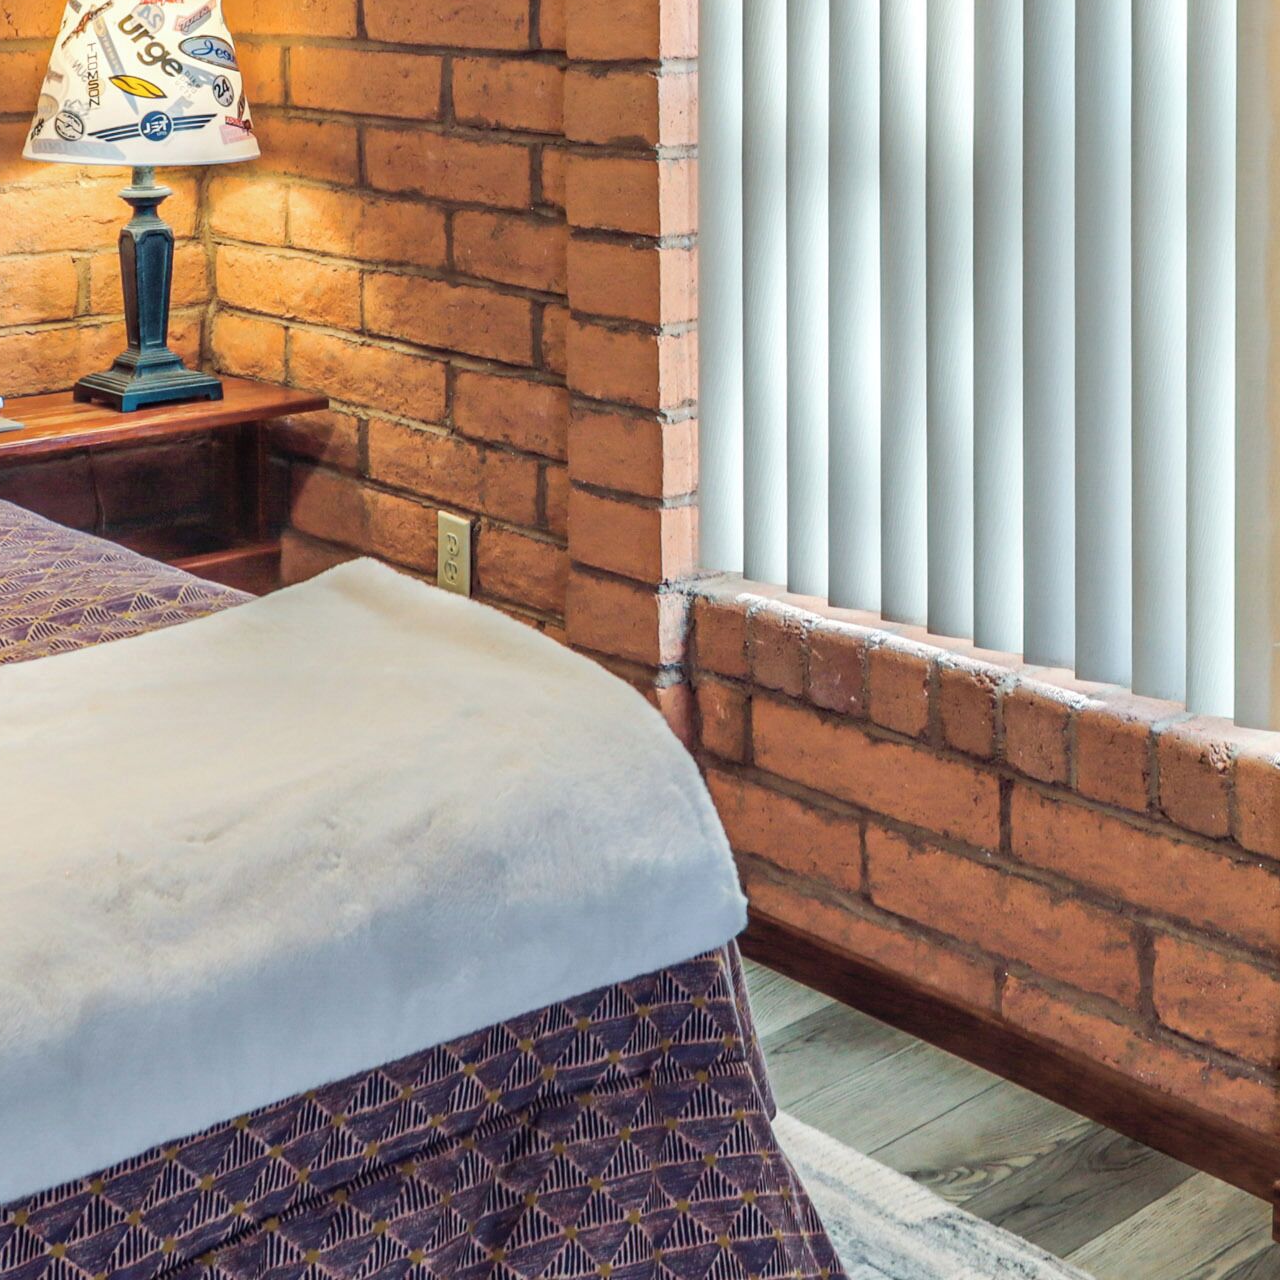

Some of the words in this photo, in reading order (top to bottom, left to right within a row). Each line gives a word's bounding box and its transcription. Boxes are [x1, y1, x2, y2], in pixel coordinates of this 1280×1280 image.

[87, 42, 100, 108] THOMSON
[118, 14, 183, 77] urge
[214, 79, 230, 99] 24
